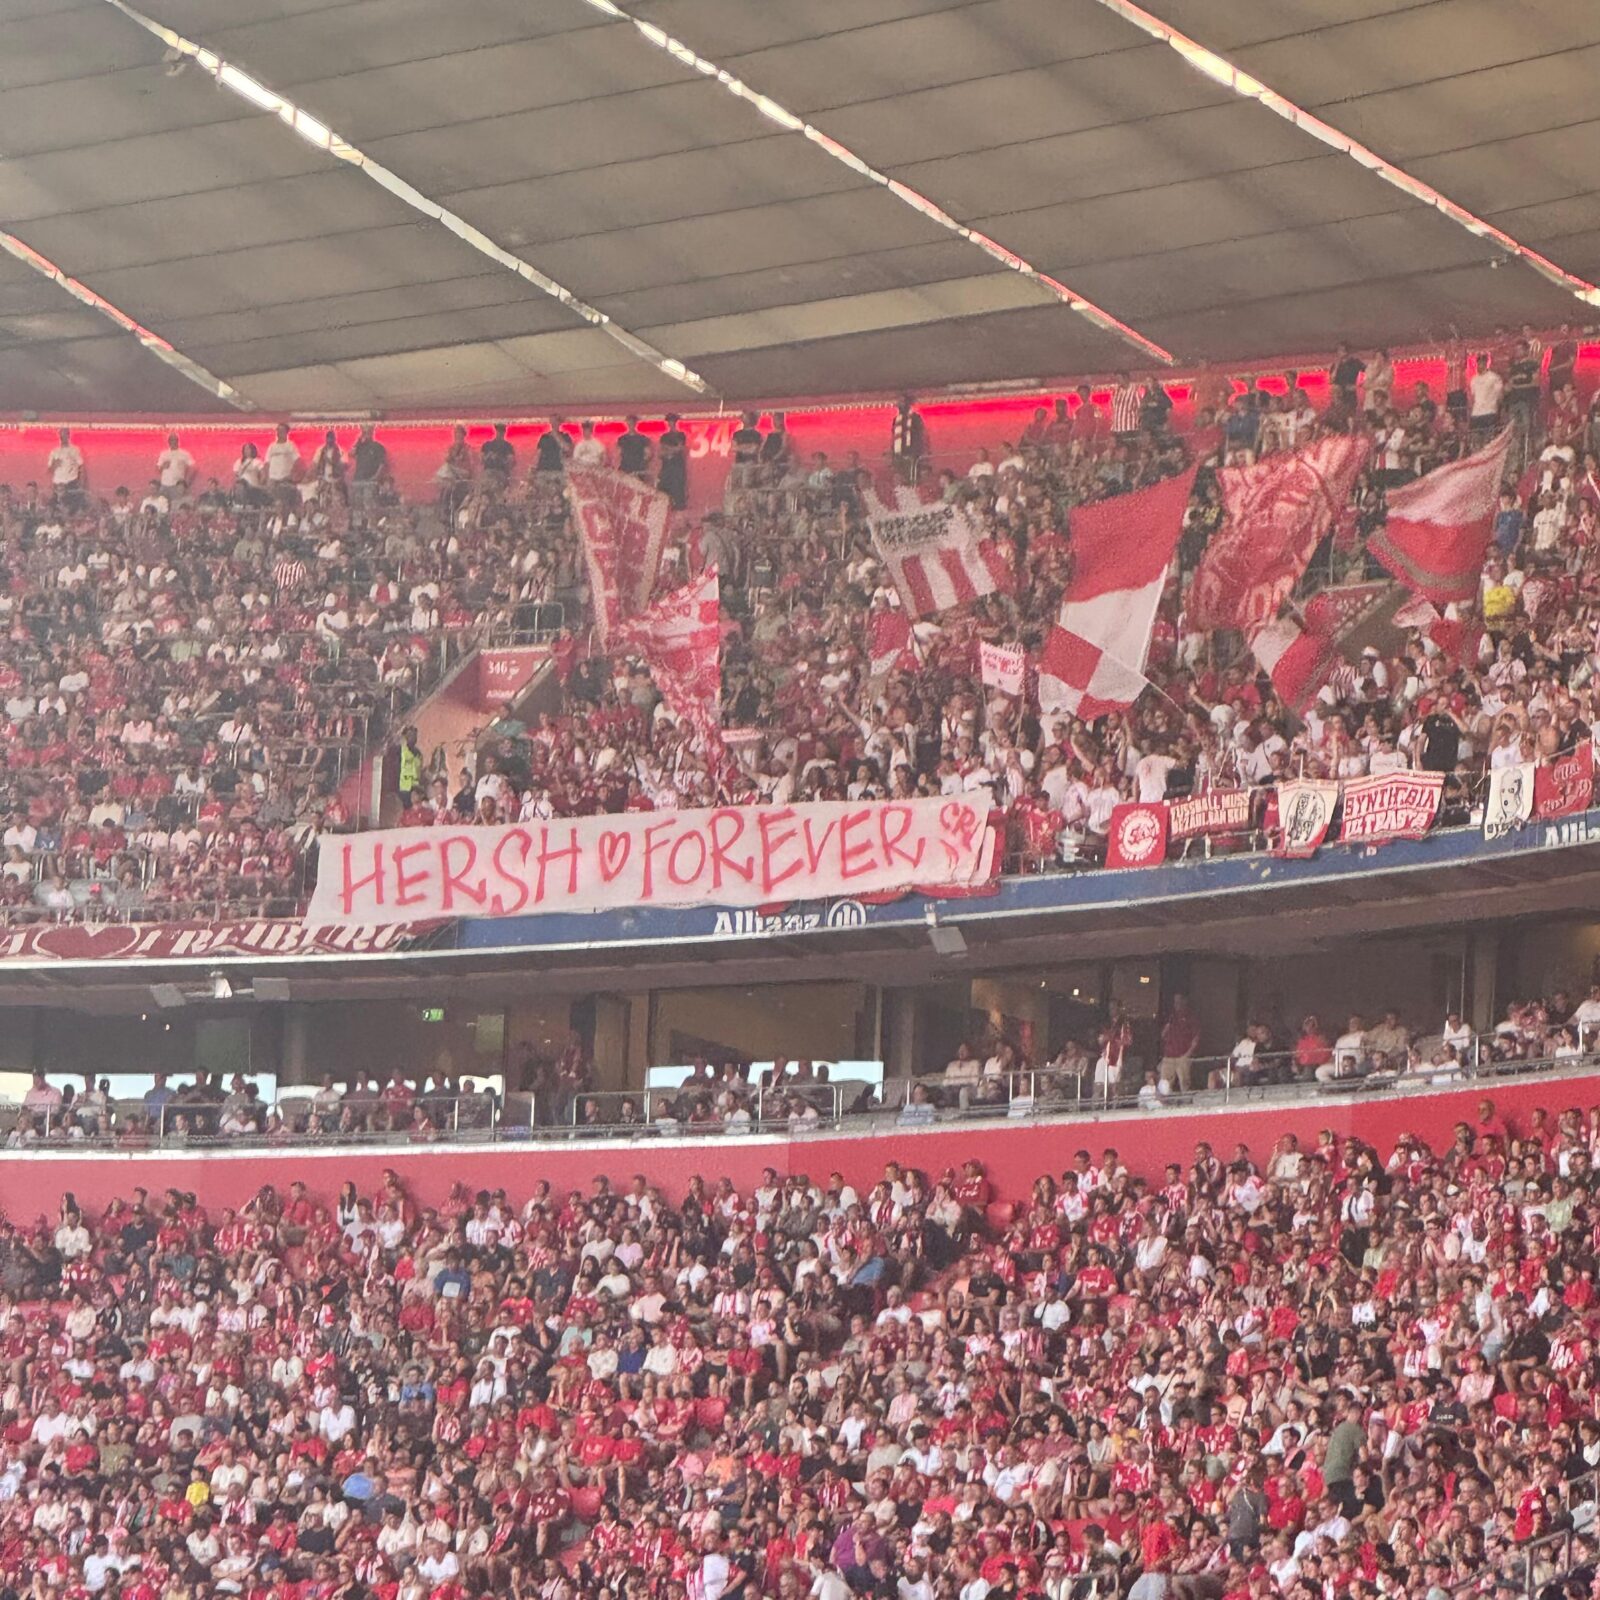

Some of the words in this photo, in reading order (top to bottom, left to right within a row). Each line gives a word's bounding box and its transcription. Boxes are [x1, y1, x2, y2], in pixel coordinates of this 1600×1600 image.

[488, 661, 507, 675] 346
[338, 827, 582, 915] HERSH
[640, 806, 926, 900] FOREVER
[713, 910, 820, 935] Allianz
